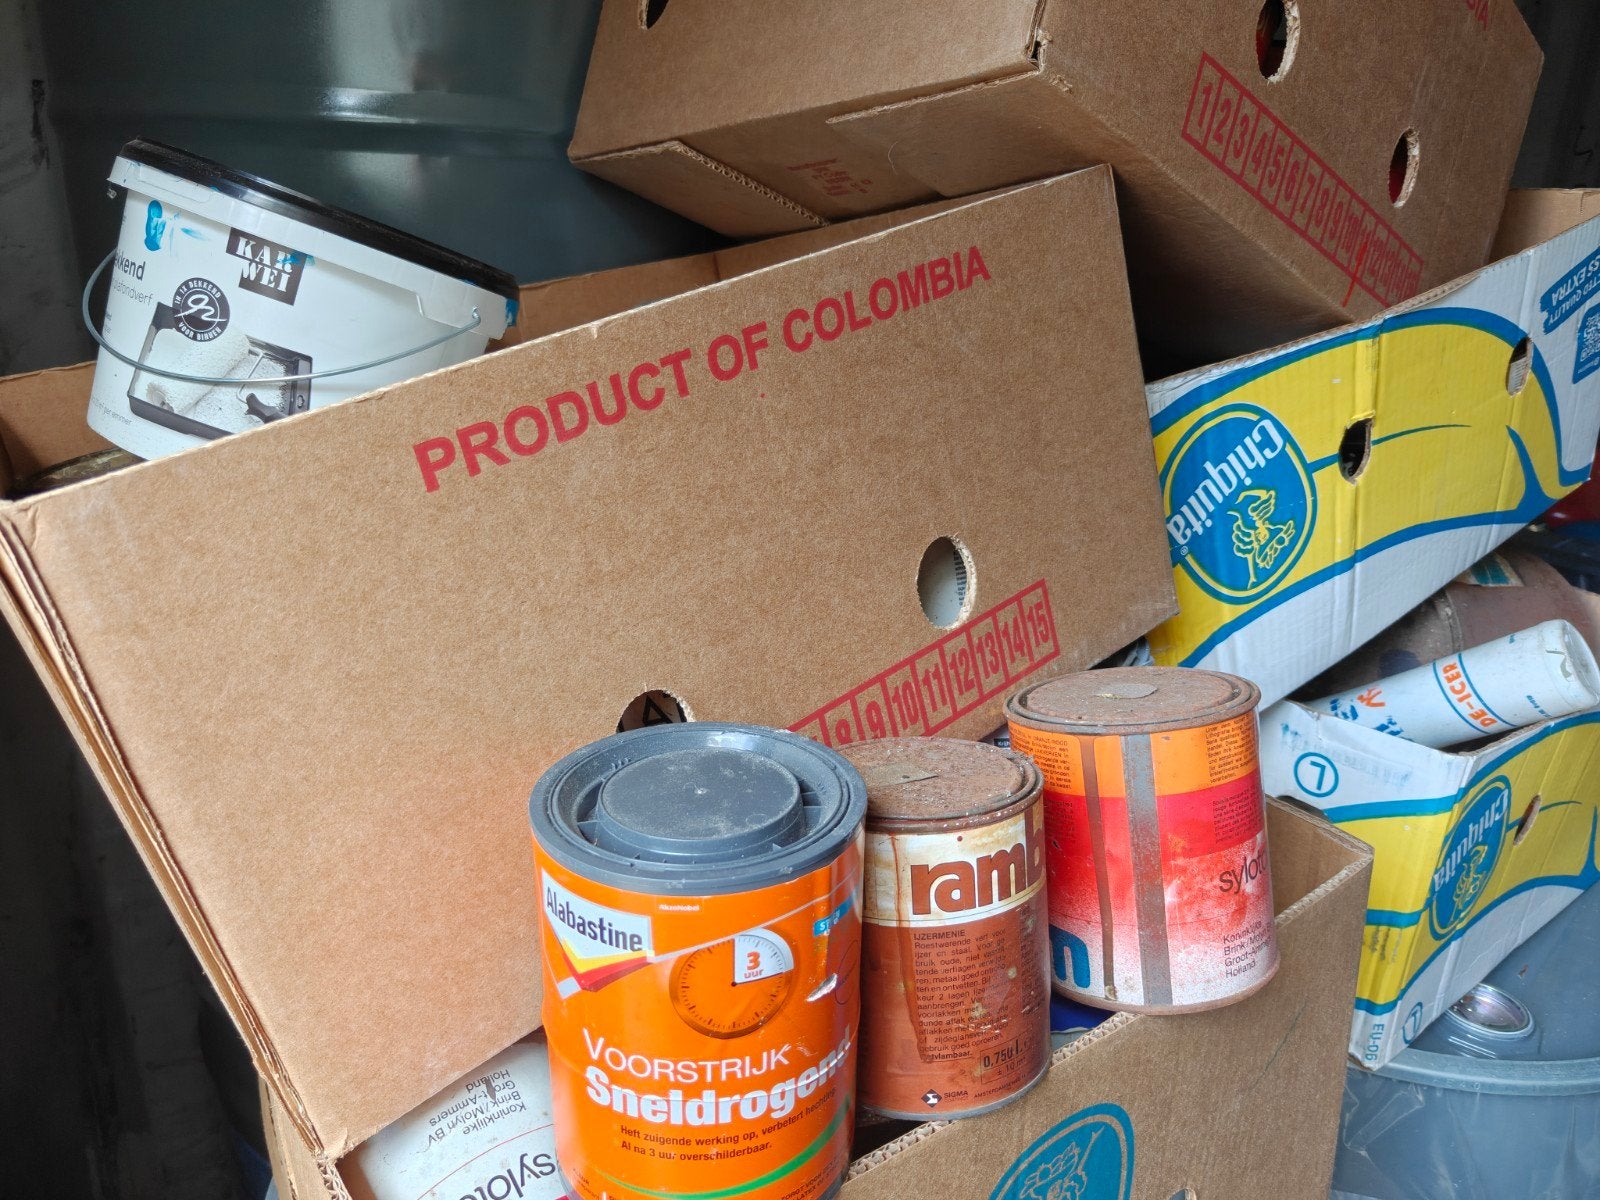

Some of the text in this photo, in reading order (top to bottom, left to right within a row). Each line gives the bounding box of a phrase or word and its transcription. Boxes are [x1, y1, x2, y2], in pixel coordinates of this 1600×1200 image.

[1198, 82, 1213, 127] 1
[1214, 98, 1231, 144] 2
[1233, 114, 1249, 159] 3
[1252, 132, 1268, 175] 4
[1268, 144, 1284, 188] 5
[1284, 160, 1300, 202] 6
[1300, 172, 1317, 213] 7
[1314, 188, 1330, 228] 8
[1329, 201, 1344, 241] 9
[1341, 213, 1361, 255] 10
[236, 237, 292, 273] KAR
[189, 279, 221, 298] DEKKEND
[241, 260, 291, 292] WEI
[1551, 266, 1587, 306] EXTRA
[178, 321, 222, 341] VOOR BINNEN
[412, 246, 991, 493] PRODUCT OF COLOMBIA
[1166, 419, 1284, 545] Chiquita
[865, 700, 886, 744] 9
[892, 682, 919, 730] 10
[923, 664, 946, 712] 11
[950, 652, 975, 697] 12
[977, 631, 1000, 679] 13
[1001, 616, 1026, 663] 14
[1028, 600, 1050, 648] 15
[1442, 662, 1497, 728] DE-ICER
[1434, 788, 1508, 892] Chiquita
[547, 886, 643, 952] Alabastine
[659, 903, 700, 912] AkzoNobel
[914, 930, 966, 941] IJZERMENIE
[915, 939, 971, 949] Roestwerende
[746, 951, 761, 971] 3
[915, 951, 932, 959] ijzer
[951, 947, 973, 956] staal.
[915, 958, 936, 967] bruik
[966, 954, 980, 963] niet
[743, 968, 764, 979] uur
[916, 968, 938, 976] tende
[961, 971, 980, 982] goed
[916, 985, 931, 993] ten
[582, 1027, 792, 1083] VOORSTRIJK
[1364, 1023, 1385, 1061] EU-06
[466, 1069, 511, 1093] Holland
[585, 1025, 851, 1127] Sneldrogend
[429, 1080, 516, 1127] Grot-Ammers
[944, 1090, 969, 1099] SIGMA
[463, 1101, 527, 1135] Koninklijke
[620, 1125, 641, 1139] Heft
[643, 1133, 692, 1146] zuigende
[697, 1134, 740, 1146] werking
[742, 1130, 759, 1143] op,
[761, 1111, 804, 1136] verbetert
[428, 1128, 446, 1148] BV
[621, 1140, 772, 1161] Al na 3 uur overschilderbaar.
